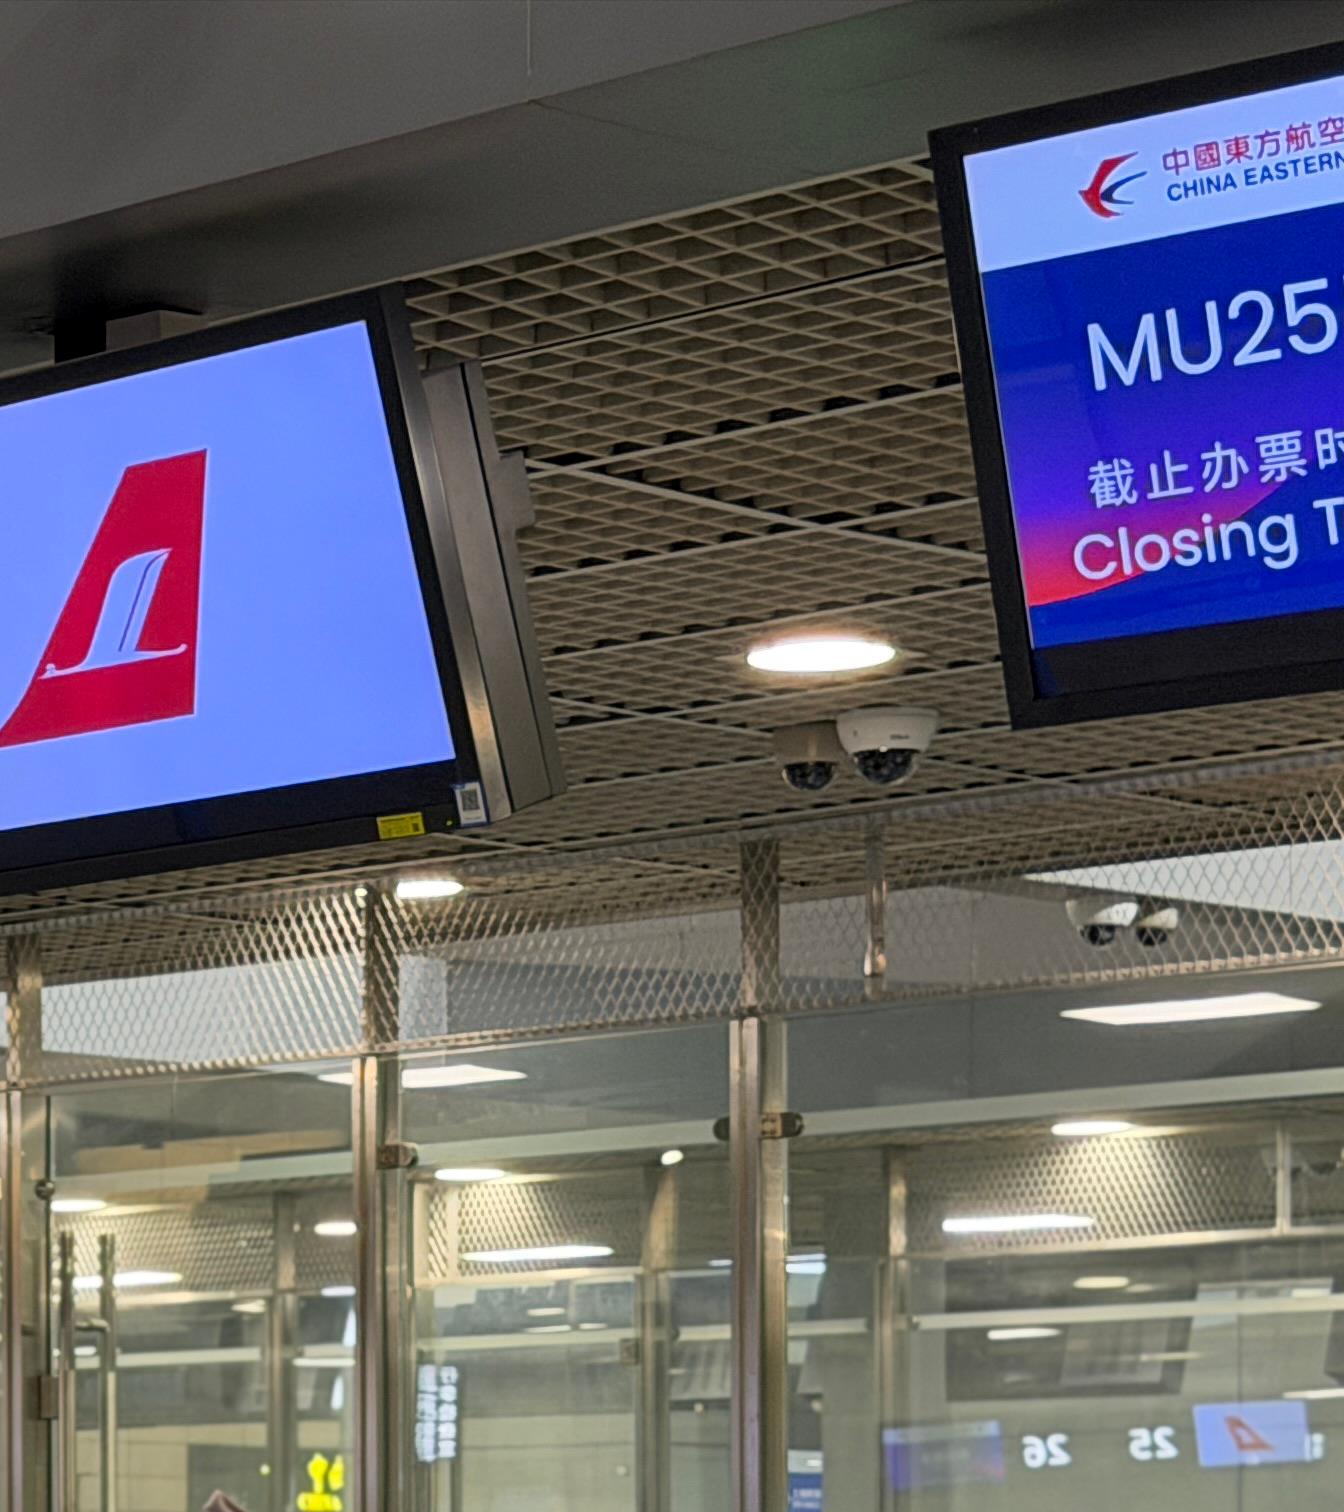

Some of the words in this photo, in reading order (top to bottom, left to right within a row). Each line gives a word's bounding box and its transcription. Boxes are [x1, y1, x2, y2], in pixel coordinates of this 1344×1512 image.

[1162, 116, 1344, 176] 中國東方航空
[1167, 172, 1238, 202] CHINA
[1087, 276, 1344, 391] MU25
[1073, 510, 1299, 583] Closing
